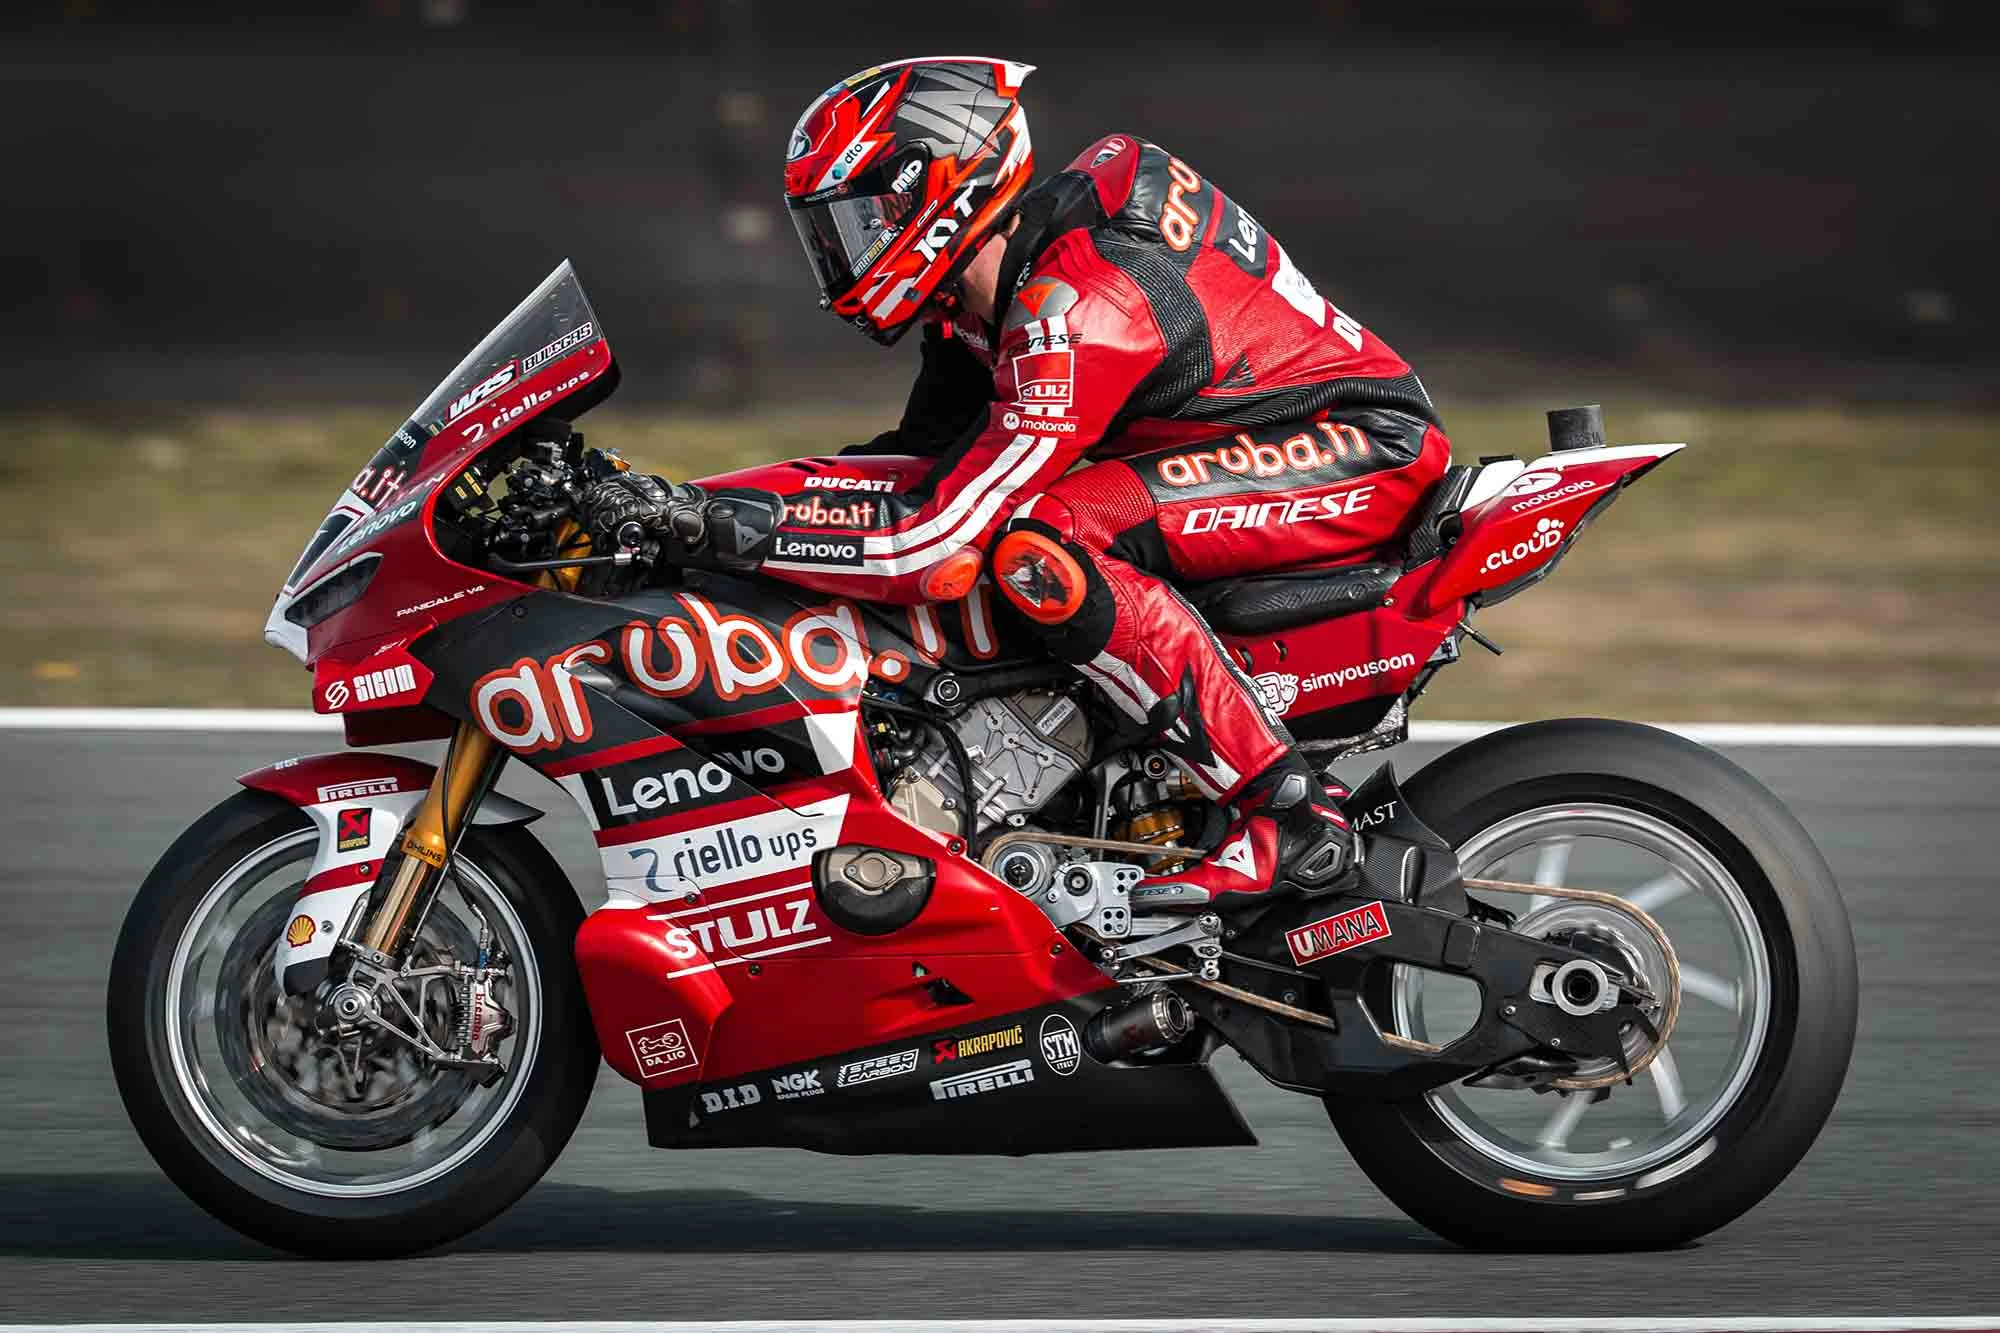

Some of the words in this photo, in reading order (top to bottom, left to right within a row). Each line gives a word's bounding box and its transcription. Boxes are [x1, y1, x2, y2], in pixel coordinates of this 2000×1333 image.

[844, 143, 863, 164] dto
[449, 364, 515, 419] WRS
[492, 390, 553, 429] riello
[556, 371, 590, 392] ups
[1021, 419, 1076, 433] motorola
[804, 476, 895, 493] DUCATI
[1511, 480, 1597, 513] motorola
[1181, 485, 1376, 535] DAINESE
[775, 537, 857, 559] Lenovo
[396, 591, 464, 617] PANIGALE
[466, 585, 485, 595] V4
[1301, 653, 1416, 692] simyousoon
[316, 777, 398, 802] PIRELLI
[601, 747, 785, 817] Lenovo
[673, 827, 763, 882] riello
[768, 827, 817, 861] ups
[664, 899, 817, 960] STULZ
[1292, 910, 1382, 957] UMANA
[1043, 1030, 1079, 1060] STM
[848, 1061, 913, 1082] CARBON
[850, 1053, 914, 1074] SPEED
[929, 1059, 1035, 1100] PIRELLI
[771, 1069, 822, 1093] NGK
